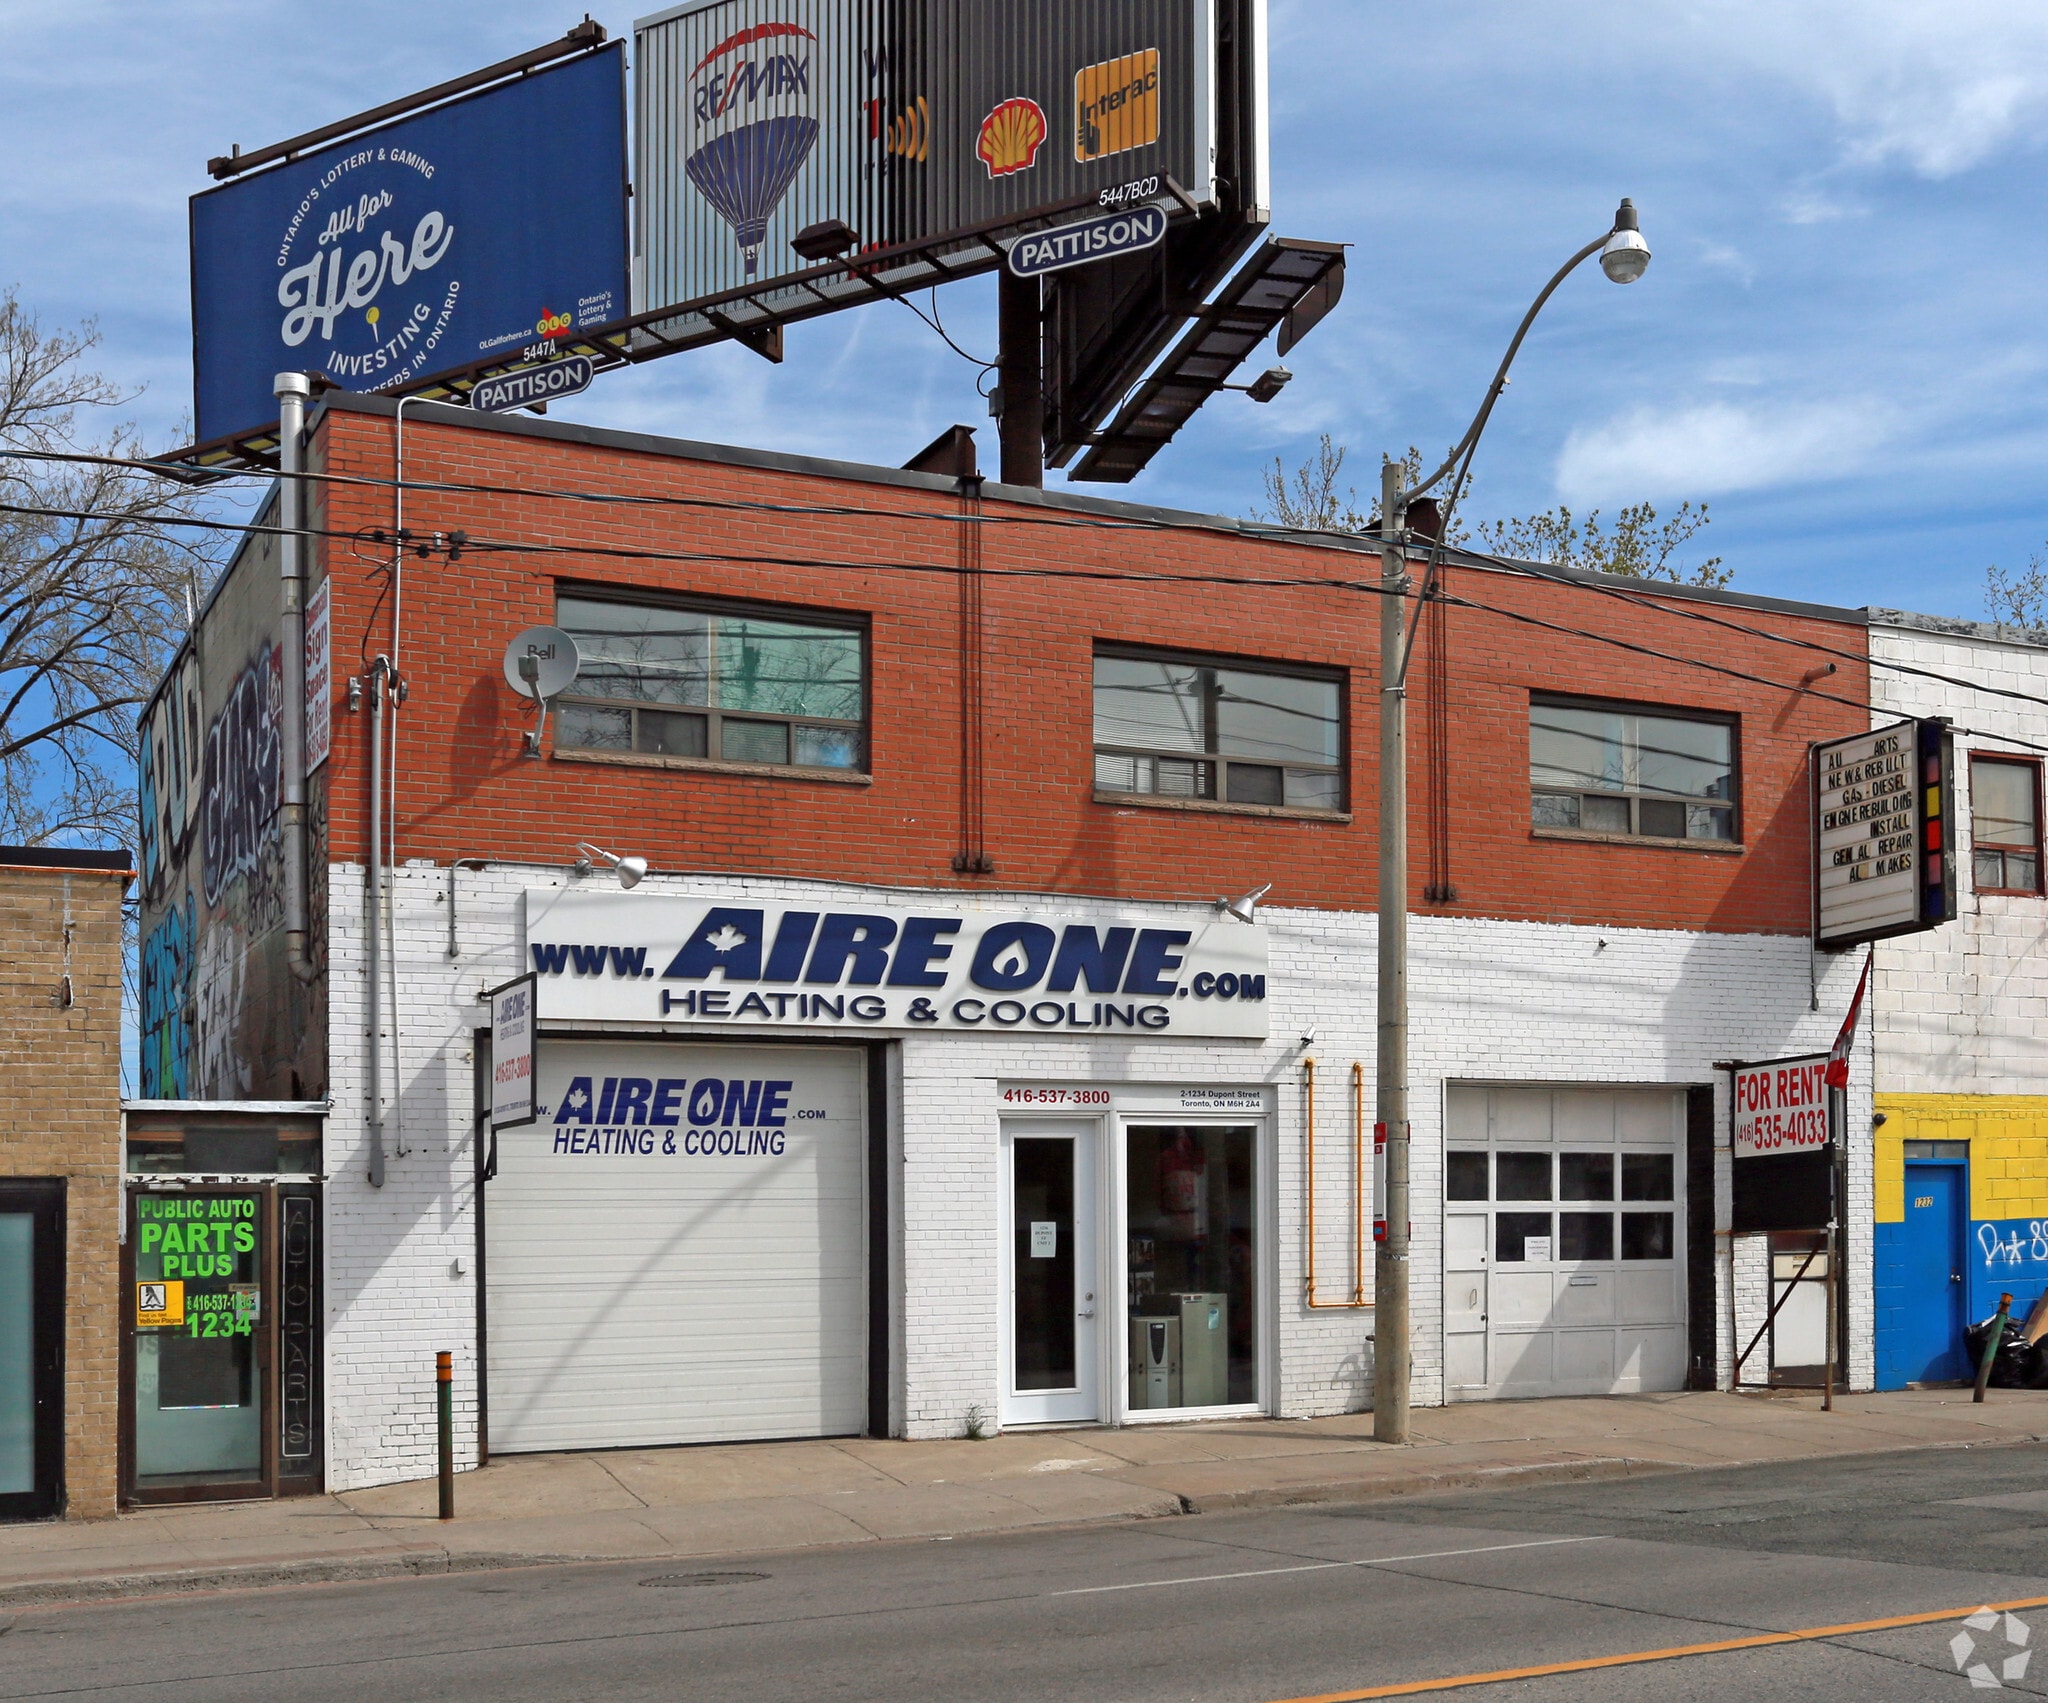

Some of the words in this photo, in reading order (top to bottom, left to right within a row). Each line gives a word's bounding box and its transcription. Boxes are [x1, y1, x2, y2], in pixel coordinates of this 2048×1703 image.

[1079, 70, 1157, 127] Interac
[1099, 176, 1159, 206] 5447BCD
[277, 187, 320, 267] ONTARIO'S
[320, 149, 374, 189] LOTTERY
[377, 147, 386, 161] &
[390, 148, 435, 180] GAMING
[318, 204, 356, 246] All
[356, 189, 393, 233] for
[1021, 214, 1154, 268] PATTISON
[278, 210, 455, 347] Here
[578, 290, 612, 307] Ontario's
[578, 303, 605, 318] Lottery
[412, 351, 428, 370] IN
[426, 280, 461, 350] ONTARIO
[537, 314, 572, 333] OLG
[578, 312, 607, 327] Gaming
[326, 303, 432, 376] INVESTING
[523, 339, 557, 362] 5447A
[480, 363, 583, 409] PATTISON
[527, 644, 556, 660] Bell
[1872, 774, 1907, 797] DIESEL
[1870, 814, 1911, 838] INSTALL
[1878, 833, 1912, 856] REPAIR
[661, 907, 963, 987] AIRE
[661, 988, 887, 1020] HEATING
[907, 997, 939, 1022] &
[953, 997, 1171, 1029] COOLING
[1003, 1088, 1110, 1105] 416-537-3800
[1180, 1090, 1206, 1099] 2-1234
[1208, 1090, 1235, 1100] Dupont
[1237, 1091, 1260, 1099] Street
[1737, 1071, 1771, 1113] FOR
[1777, 1064, 1826, 1108] RENT
[553, 1076, 686, 1125] AIRE
[687, 1077, 793, 1127] ONE
[1181, 1100, 1211, 1109] Toronto,
[553, 1128, 654, 1155] HEATING
[662, 1129, 677, 1155] &
[685, 1129, 786, 1156] COOLING
[140, 1200, 204, 1219] PUBLIC
[208, 1199, 255, 1218] AUTO
[1914, 1196, 1934, 1209] 1232
[140, 1221, 255, 1254] PARTS
[163, 1254, 233, 1277] PLUS
[138, 1317, 161, 1325] Yellow
[161, 1317, 182, 1325] Pages
[186, 1312, 252, 1338] 1234
